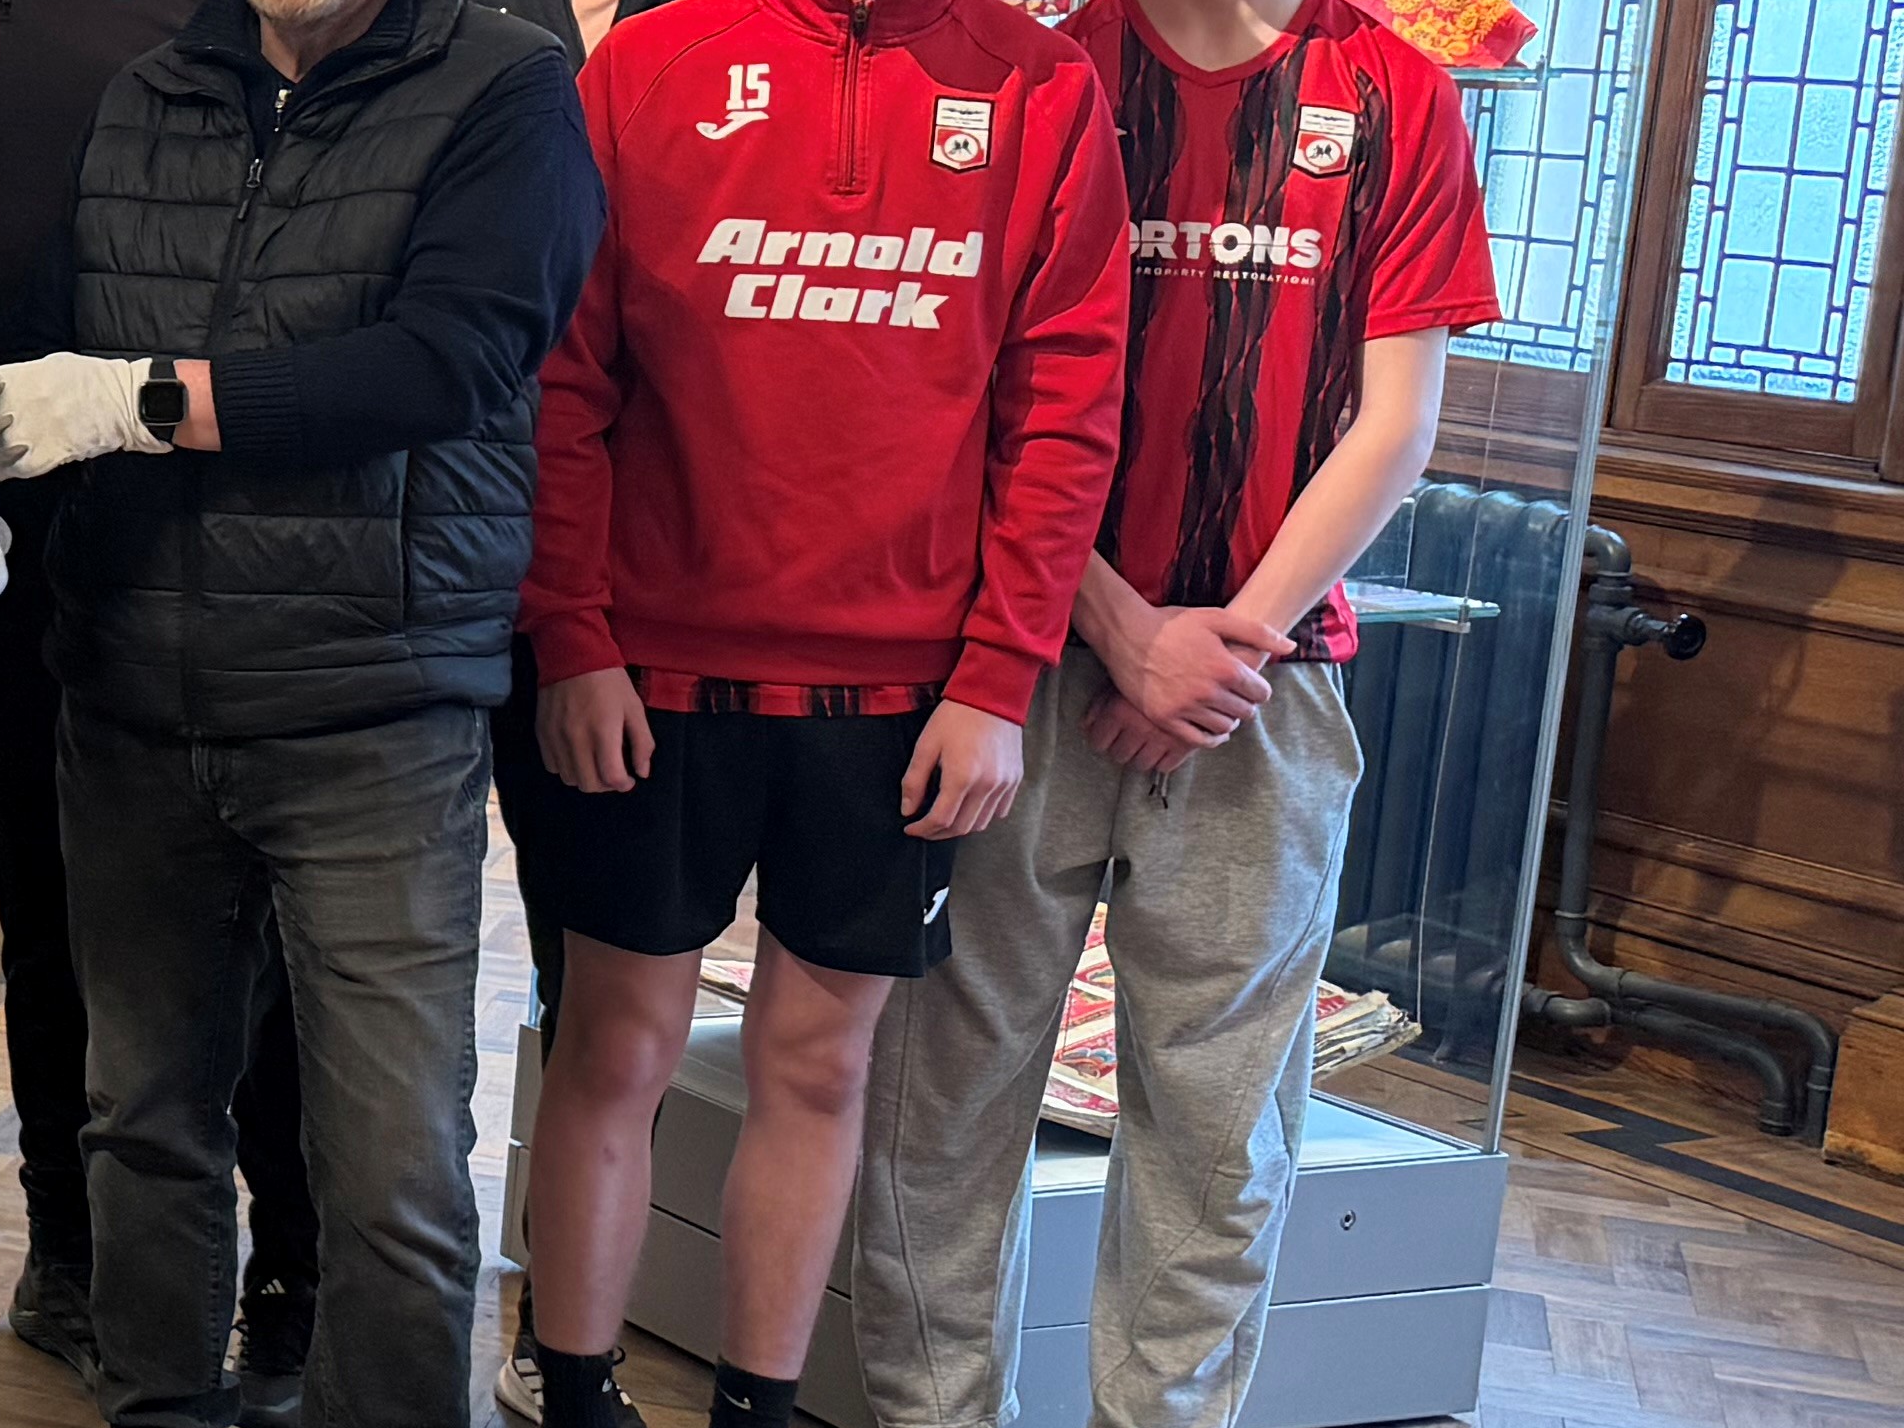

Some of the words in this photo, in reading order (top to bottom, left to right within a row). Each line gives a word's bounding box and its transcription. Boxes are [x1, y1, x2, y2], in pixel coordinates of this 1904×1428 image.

[725, 63, 770, 110] 15
[696, 218, 983, 277] Arnold
[724, 274, 949, 330] Clark
